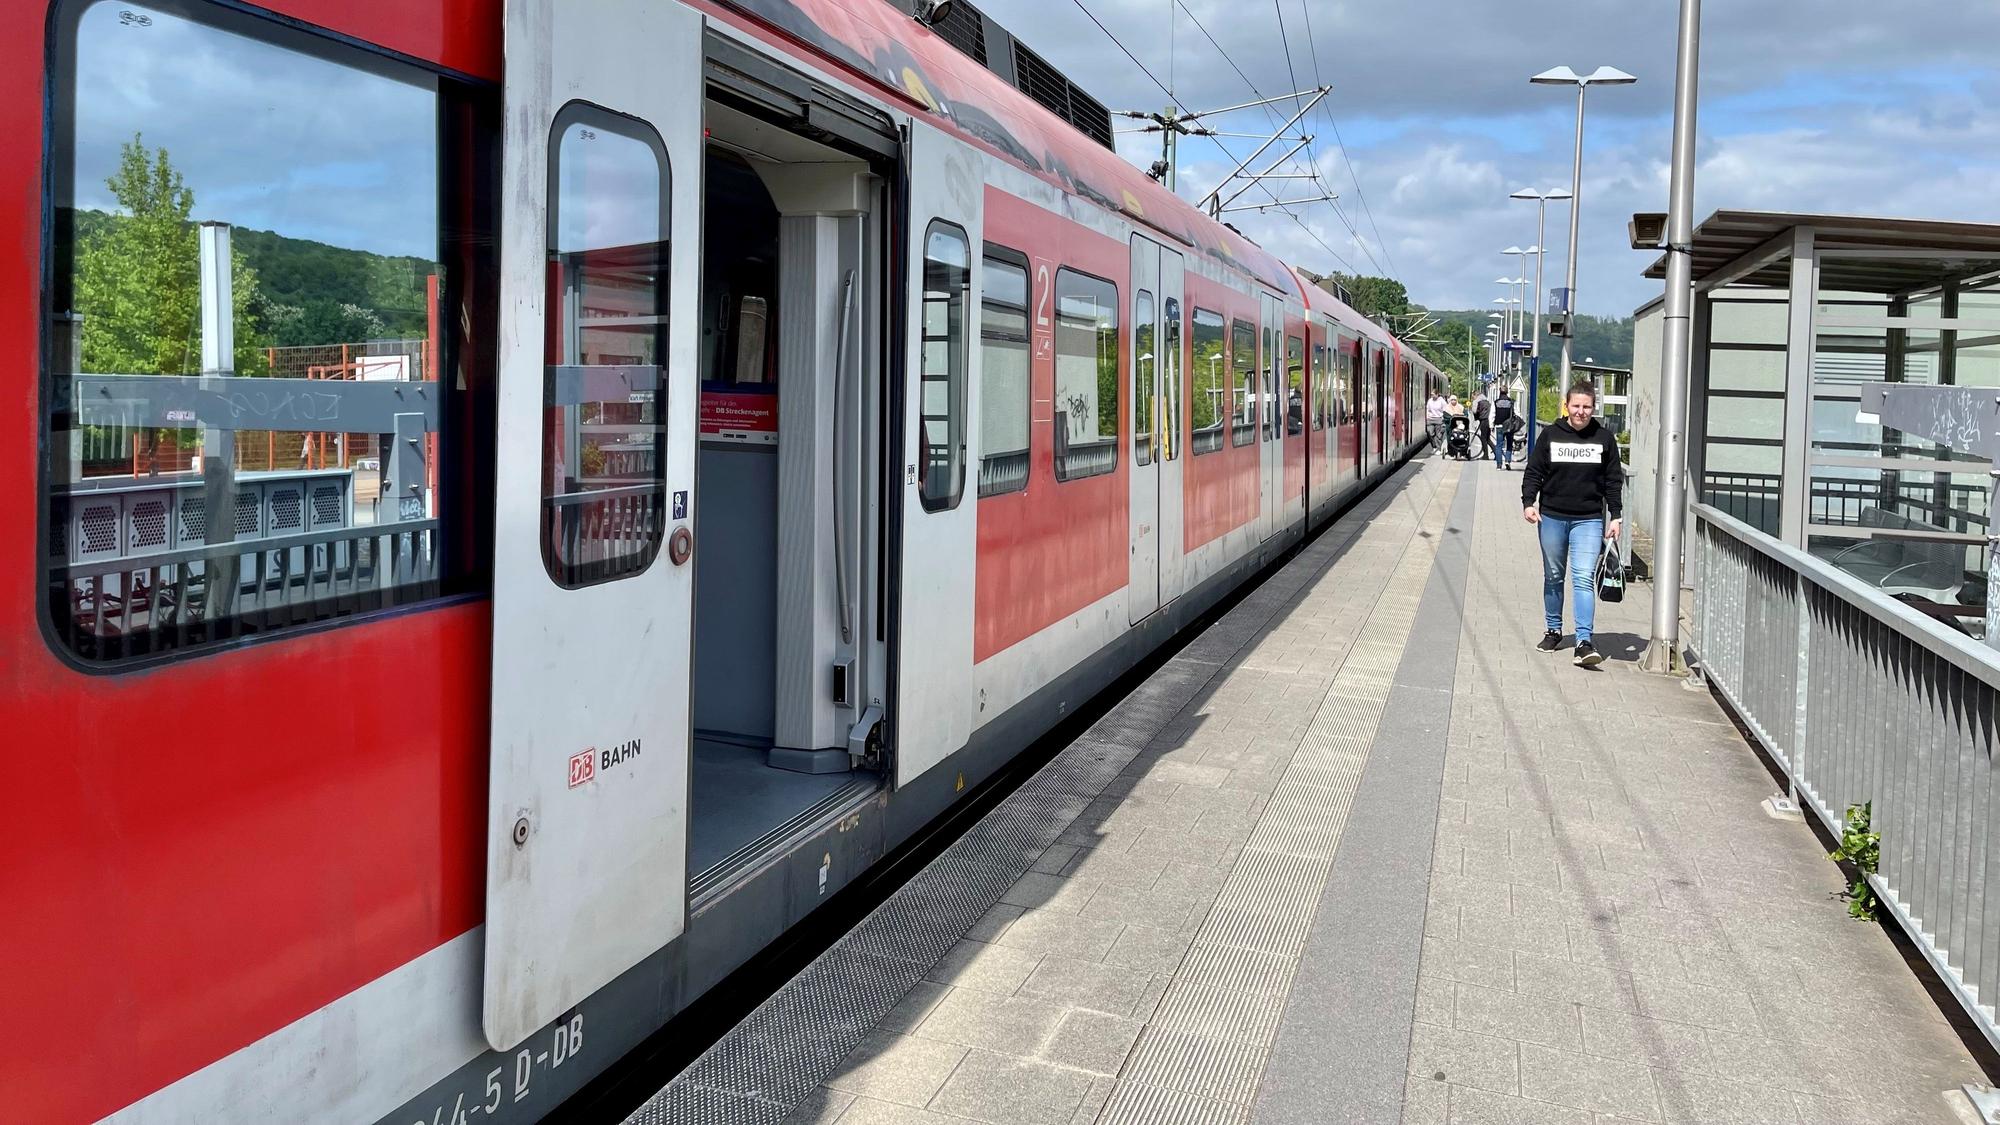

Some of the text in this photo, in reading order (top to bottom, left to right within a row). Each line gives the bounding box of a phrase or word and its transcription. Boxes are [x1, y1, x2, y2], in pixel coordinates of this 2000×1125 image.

[1037, 265, 1049, 326] 2
[725, 408, 769, 417] Streckenagent
[570, 739, 641, 786] DB BAHN
